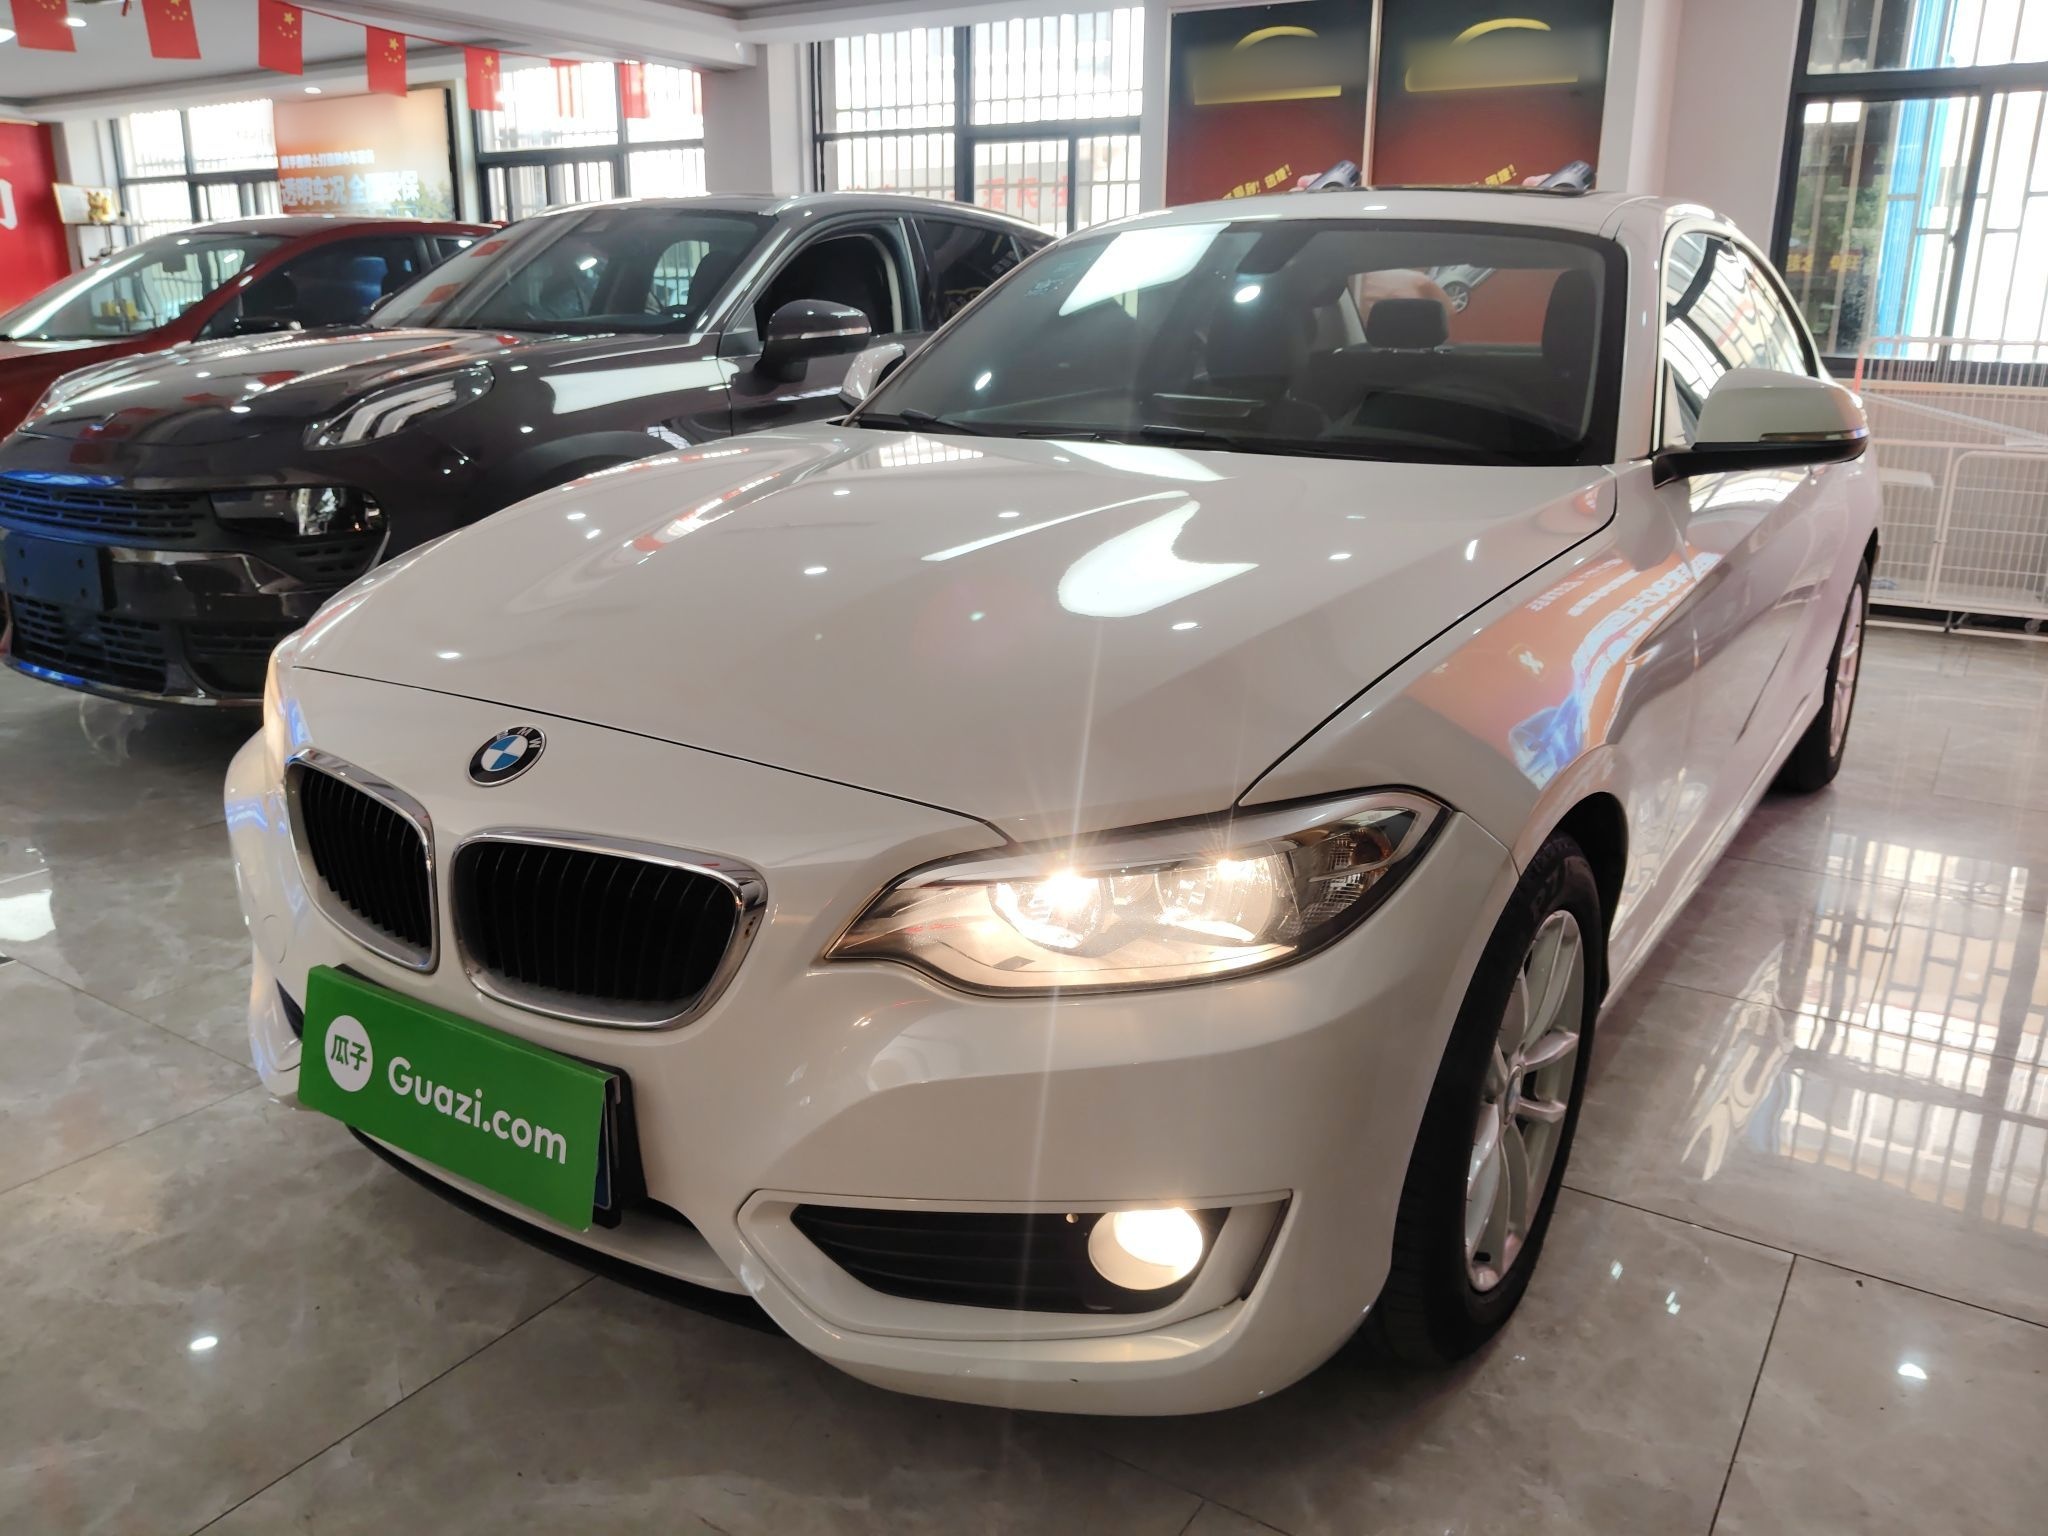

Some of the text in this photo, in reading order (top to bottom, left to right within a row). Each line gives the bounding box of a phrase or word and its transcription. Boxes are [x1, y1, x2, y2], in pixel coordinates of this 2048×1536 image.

[347, 170, 420, 204] 全保
[330, 1034, 368, 1071] 瓜子
[388, 1056, 567, 1164] Guazi.com
